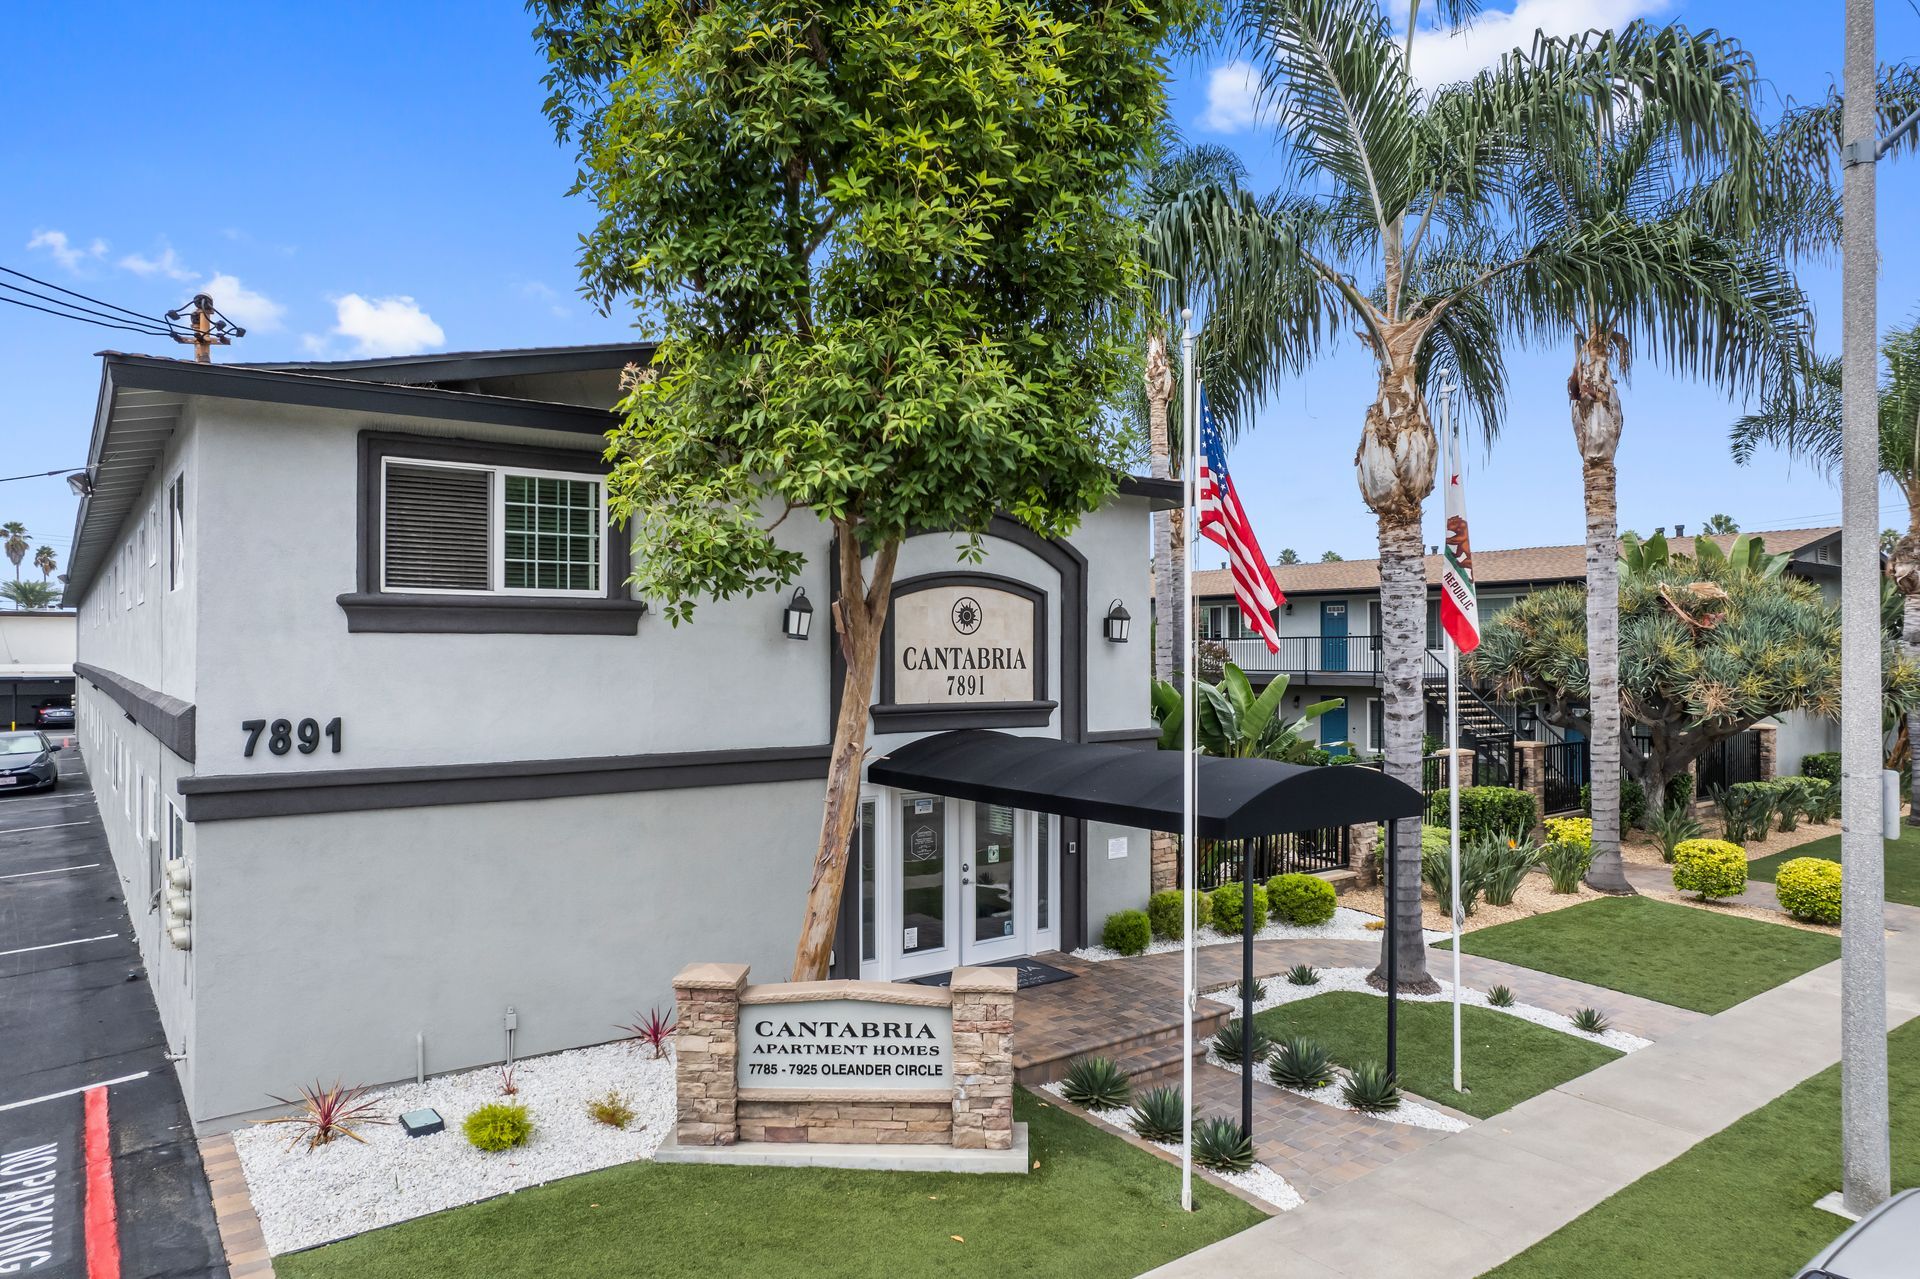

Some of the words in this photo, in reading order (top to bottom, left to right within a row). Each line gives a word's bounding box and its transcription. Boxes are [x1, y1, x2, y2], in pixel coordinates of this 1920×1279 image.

[1443, 571, 1474, 611] REPUBLIC
[902, 646, 1027, 671] CANTABRIA
[946, 675, 985, 696] 7891
[242, 717, 342, 757] 7891
[754, 1020, 937, 1039] CANTABRIA
[752, 1043, 868, 1055] APARTMENT
[872, 1044, 940, 1056] HOMES
[748, 1063, 778, 1075] 7785
[788, 1063, 818, 1075] 7925
[821, 1063, 892, 1076] OLEANDER
[895, 1064, 943, 1077] CIRCLE
[0, 1142, 58, 1176] NO
[0, 1169, 57, 1274] PARKING
